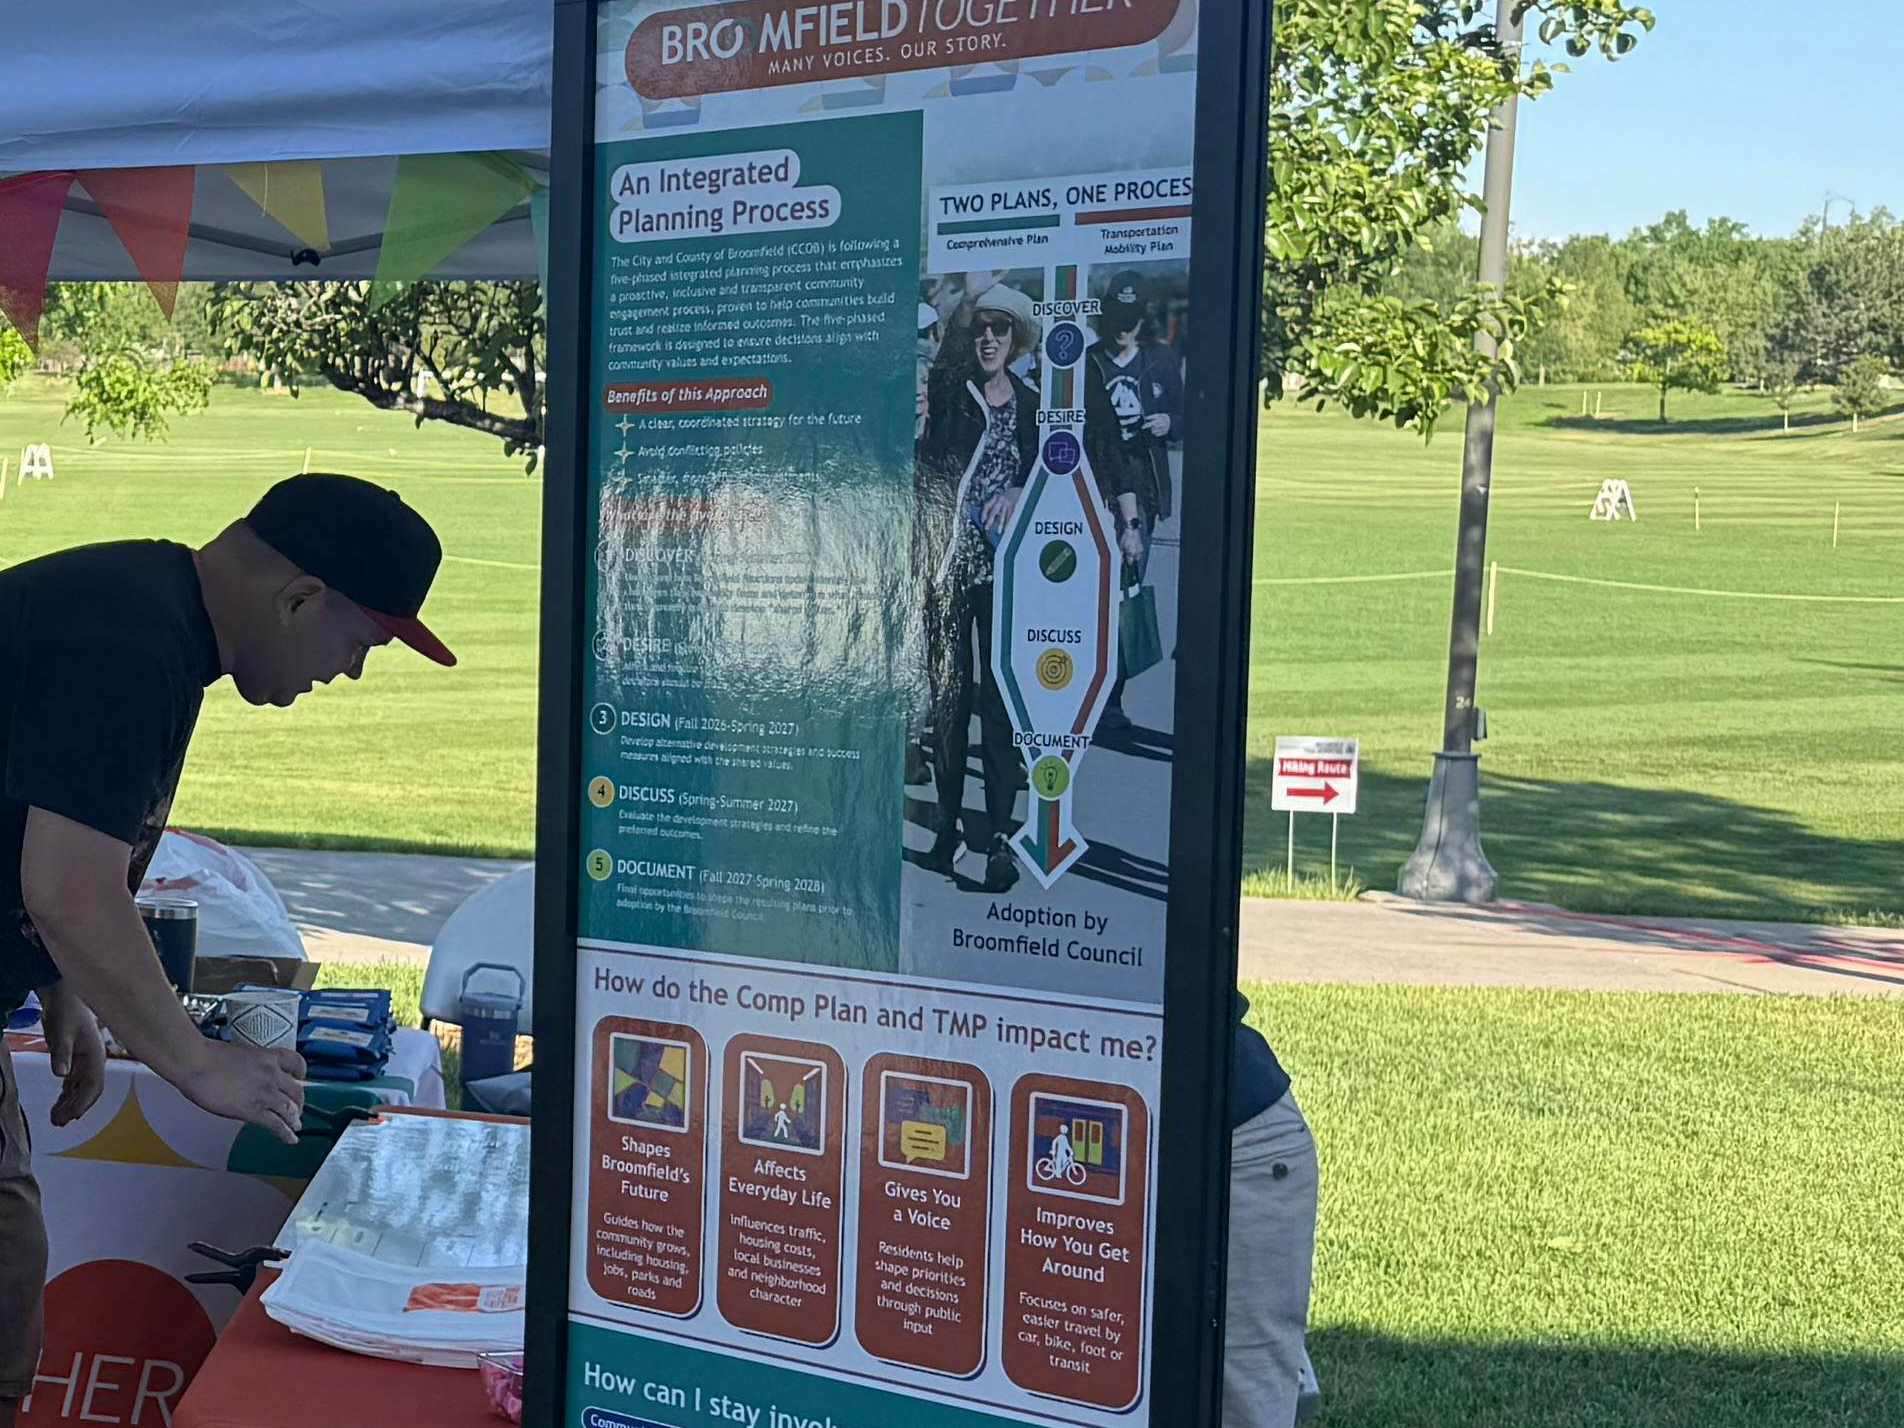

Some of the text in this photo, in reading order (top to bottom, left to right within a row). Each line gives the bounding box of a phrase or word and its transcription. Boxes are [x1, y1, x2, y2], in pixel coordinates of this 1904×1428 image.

[768, 32, 1006, 74] MANY VOICES. OUR STORY.
[618, 155, 788, 196] An Integrated
[939, 194, 983, 214] TWO
[991, 188, 1057, 211] PLANS,
[1066, 184, 1107, 205] ONE
[619, 199, 829, 234] Planning Process
[946, 233, 1048, 251] Comprehensive Plan
[1100, 225, 1178, 239] Transportation
[1103, 240, 1173, 255] Mobility Plan
[1033, 300, 1101, 317] DISCOVER
[607, 384, 767, 405] Benefits of this Approach
[1036, 409, 1085, 424] DESIRE
[1034, 521, 1084, 536] DESIGN
[1026, 628, 1082, 644] DISCUSS
[599, 710, 799, 736] 3 DESIGN (Fall 2026-Spring 2027)
[1013, 732, 1090, 748] DOCUMENT
[1282, 761, 1347, 775] Hiking Route
[598, 784, 798, 812] 4 DISCUSS (Spring-Summer 2027)
[595, 858, 824, 893] 5 DOCUMENT (Fall 2027-Spring 2028)
[986, 902, 1108, 935] Adoption by
[953, 928, 1142, 966] Broomfield Council
[594, 966, 1156, 1061] How do the Comp Plan and TMP impact me?
[621, 1136, 670, 1158] Shapes
[602, 1156, 689, 1183] Broomfield's
[754, 1159, 806, 1181] Affects
[621, 1181, 668, 1202] Future
[729, 1176, 831, 1209] Everyday Life
[884, 1181, 960, 1208] Gives You
[893, 1209, 950, 1230] a Voice
[1036, 1207, 1114, 1234] Improves
[1021, 1227, 1129, 1262] How You Get
[1042, 1261, 1104, 1282] Around
[584, 1361, 635, 1395] How
[643, 1382, 685, 1408] can
[695, 1387, 700, 1411] I
